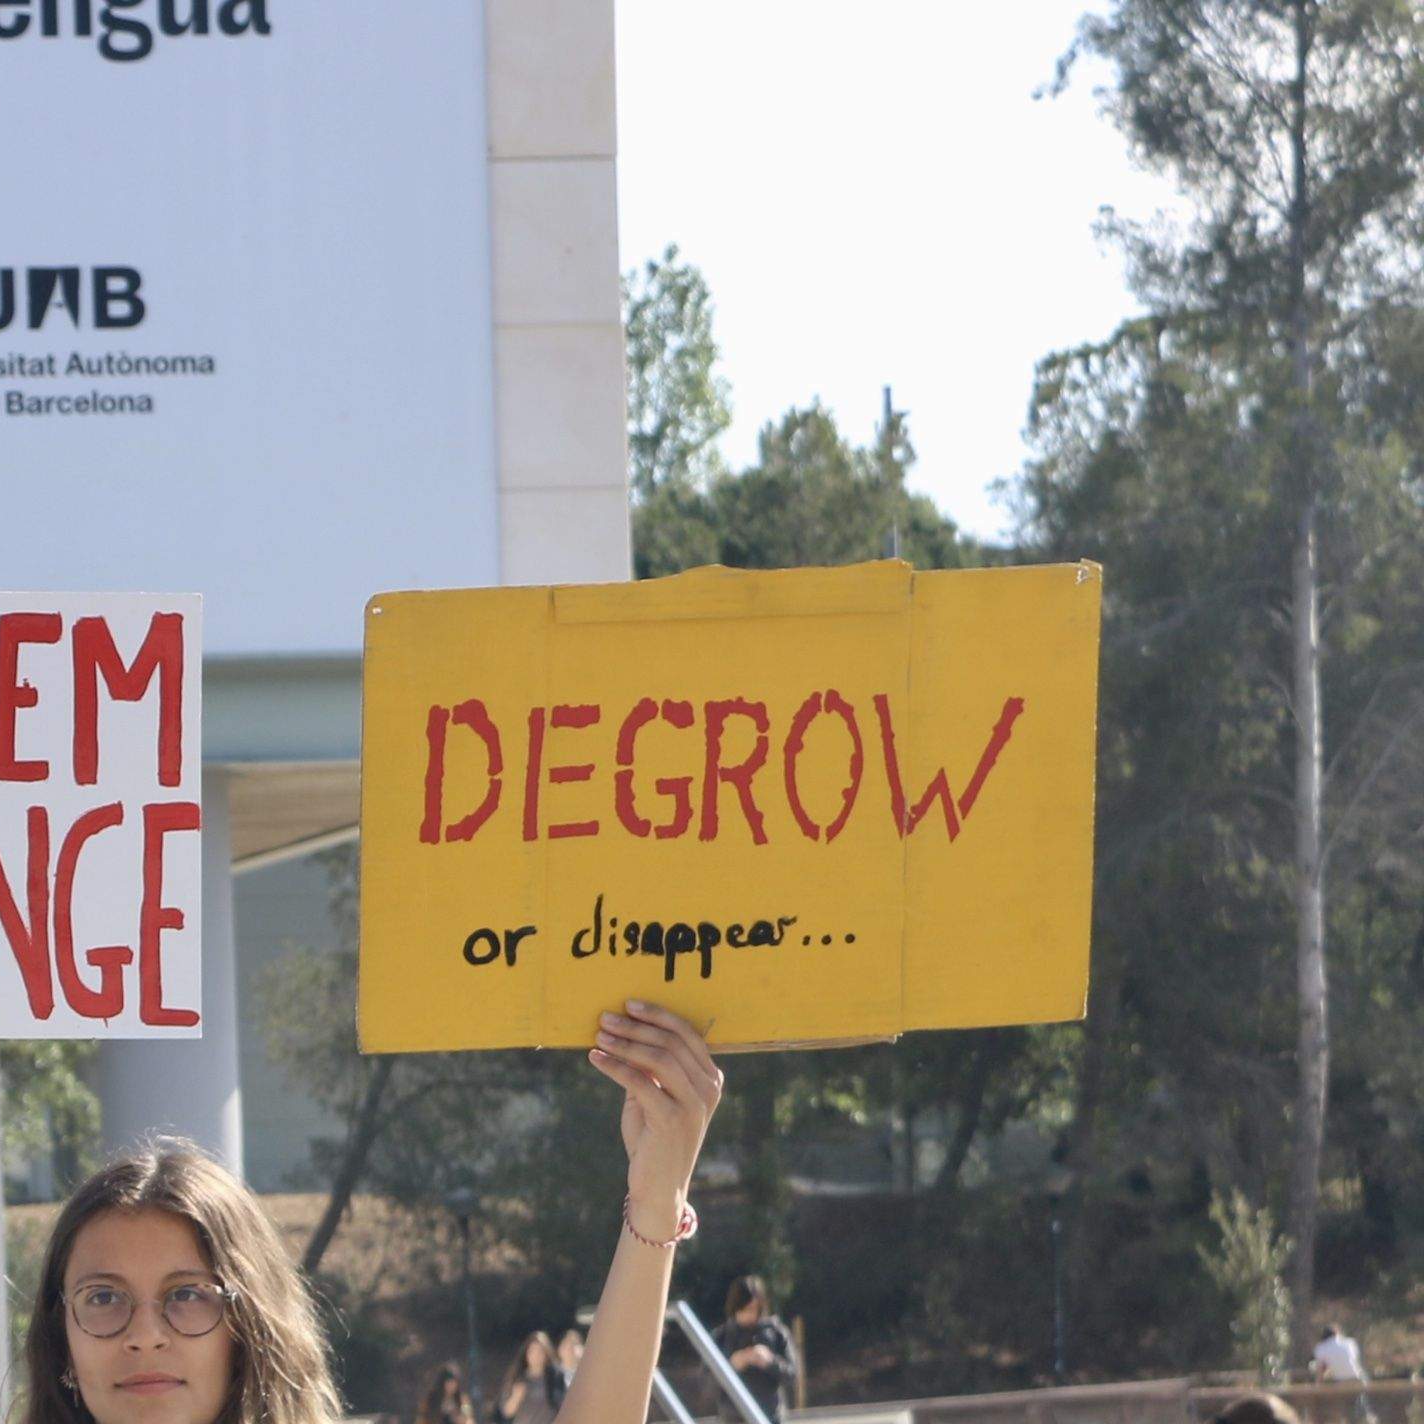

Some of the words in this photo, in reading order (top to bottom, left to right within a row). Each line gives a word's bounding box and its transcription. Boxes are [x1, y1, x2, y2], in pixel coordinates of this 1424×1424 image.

[64, 350, 216, 377] Autònoma
[5, 391, 154, 416] Barcelona
[418, 689, 1025, 846] DEGROW
[462, 923, 538, 967] or
